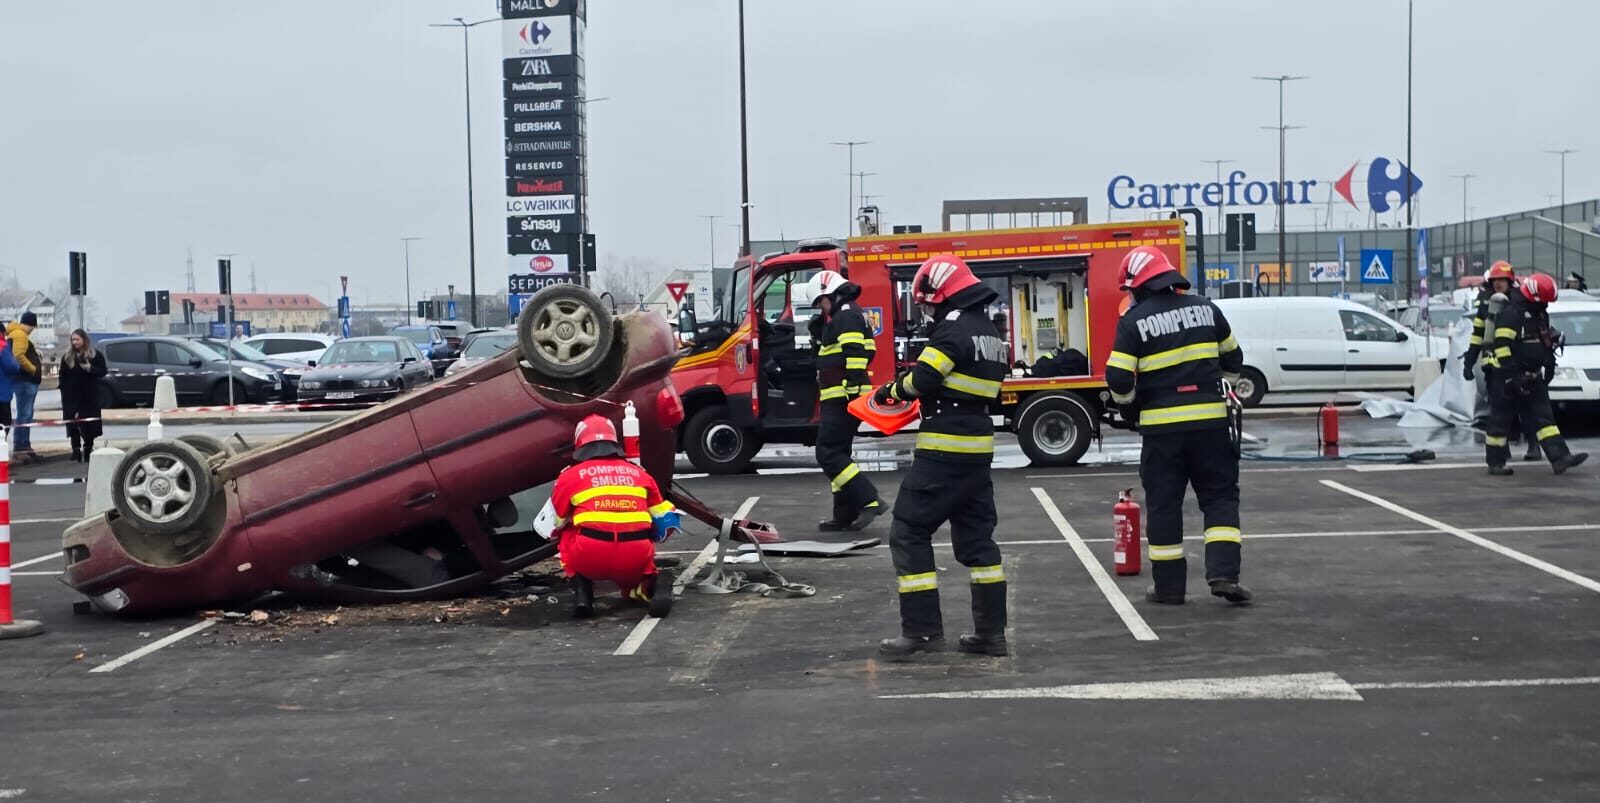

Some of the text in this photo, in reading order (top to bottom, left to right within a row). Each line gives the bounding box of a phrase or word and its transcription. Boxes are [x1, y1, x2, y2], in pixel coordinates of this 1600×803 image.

[510, 0, 543, 11] MALL
[521, 60, 552, 75] ZARA
[514, 121, 562, 132] BERSHKA
[513, 141, 571, 151] STRADIVARIUS
[515, 161, 563, 170] RESERVED
[1107, 170, 1317, 210] Carrefour
[506, 200, 522, 212] LC
[520, 216, 561, 233] sinsay
[1136, 305, 1215, 342] POMPIERII
[579, 466, 640, 479] POMPIERII
[591, 476, 634, 487] SMURD
[594, 500, 637, 509] PARAMEDIC
